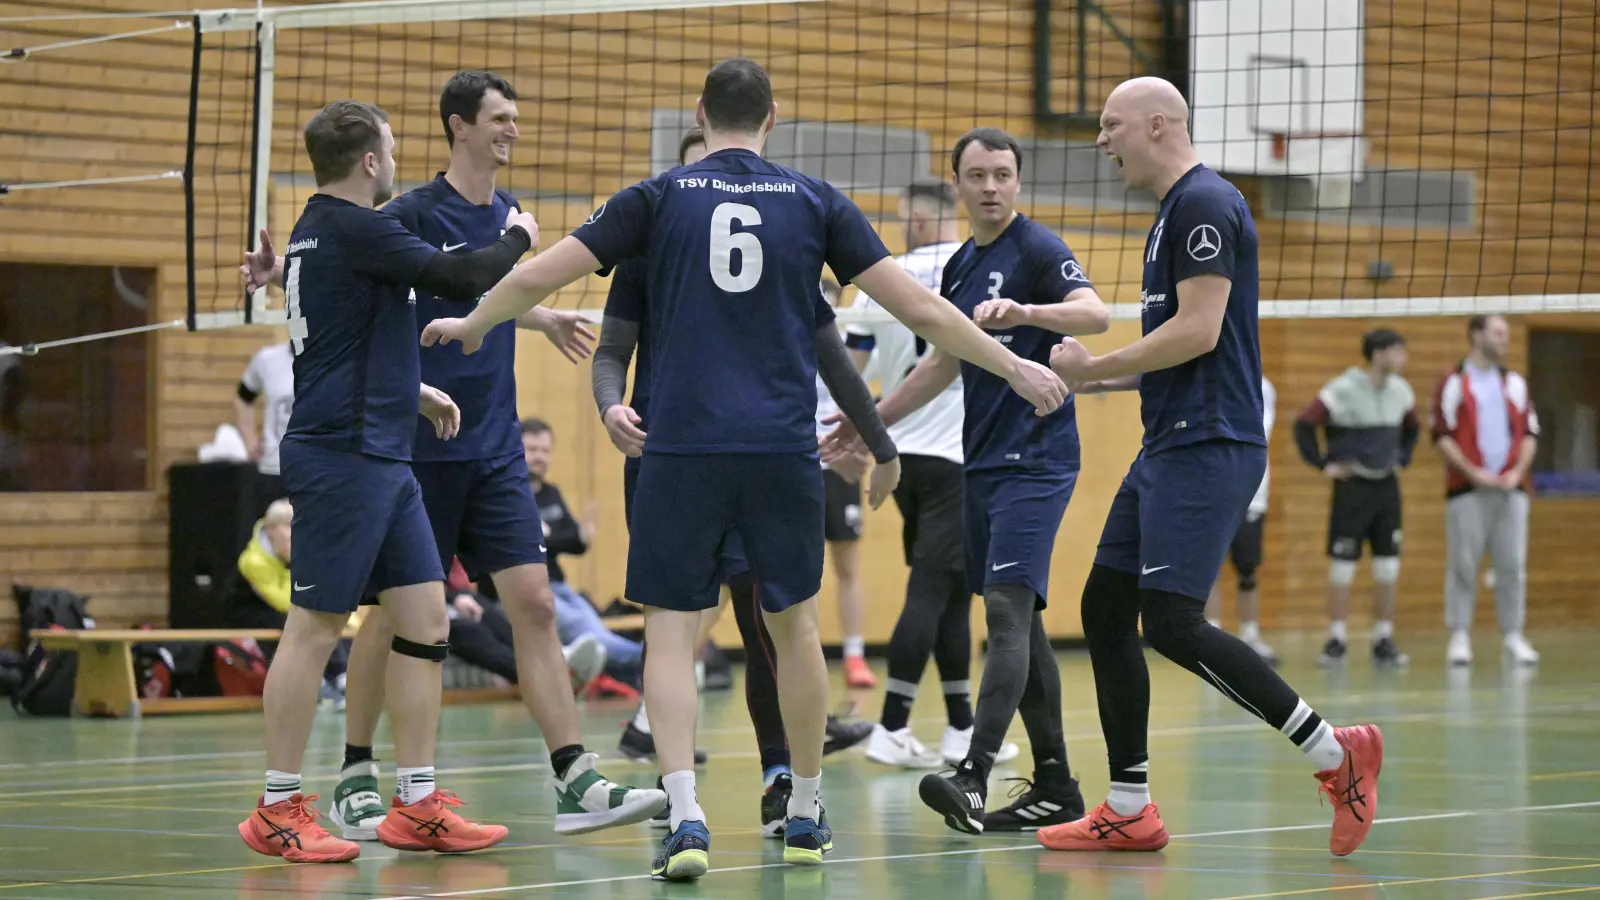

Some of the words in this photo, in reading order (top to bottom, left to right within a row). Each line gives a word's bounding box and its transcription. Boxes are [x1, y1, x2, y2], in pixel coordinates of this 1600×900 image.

[677, 178, 708, 189] TSV
[712, 179, 796, 193] Dinkelsbühl
[709, 202, 763, 292] 6
[285, 256, 308, 356] 4
[987, 271, 1004, 300] 3
